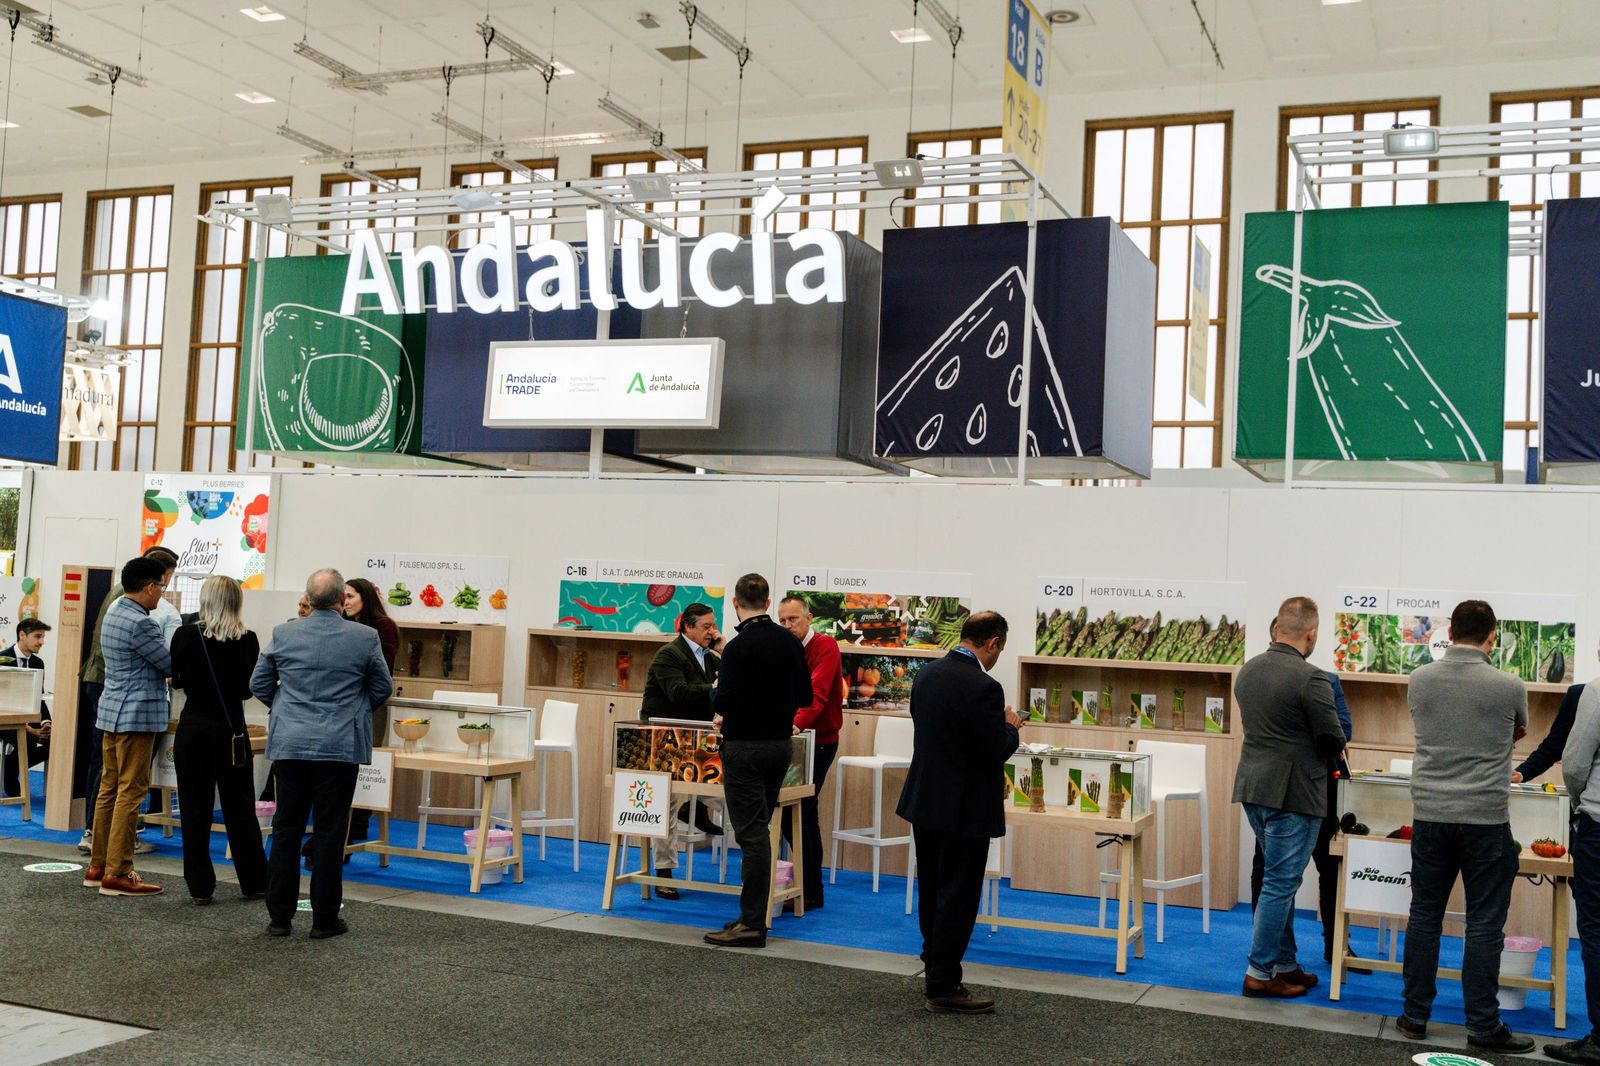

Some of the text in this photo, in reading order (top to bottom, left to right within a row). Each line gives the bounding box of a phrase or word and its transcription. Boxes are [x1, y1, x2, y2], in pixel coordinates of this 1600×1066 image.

[1011, 23, 1025, 66] 18
[1035, 47, 1043, 87] B
[339, 184, 846, 315] Andalucía
[506, 373, 557, 383] Andalucía
[650, 374, 673, 382] Junta
[506, 385, 541, 395] TRADE
[660, 382, 700, 391] Andalucía
[202, 480, 245, 489] PLUS BERRIES
[188, 537, 210, 554] Plus
[367, 559, 386, 569] C-14
[399, 560, 436, 570] FULGENCIO
[453, 562, 466, 571] S.L.
[566, 565, 588, 576] C-16
[602, 568, 704, 580] S.A.T. CAMPOS DE GRANADA
[793, 575, 817, 586] C-18
[833, 577, 867, 587] GUADEX
[1044, 585, 1074, 596] C-20
[1156, 589, 1186, 599] S.C.A.
[1344, 595, 1377, 608] C-22
[1396, 598, 1440, 608] PROCAM
[860, 613, 884, 622] guadex
[359, 767, 381, 776] ampos
[358, 774, 387, 783] Granada
[618, 810, 662, 827] guadex
[1351, 870, 1407, 885] Procam
